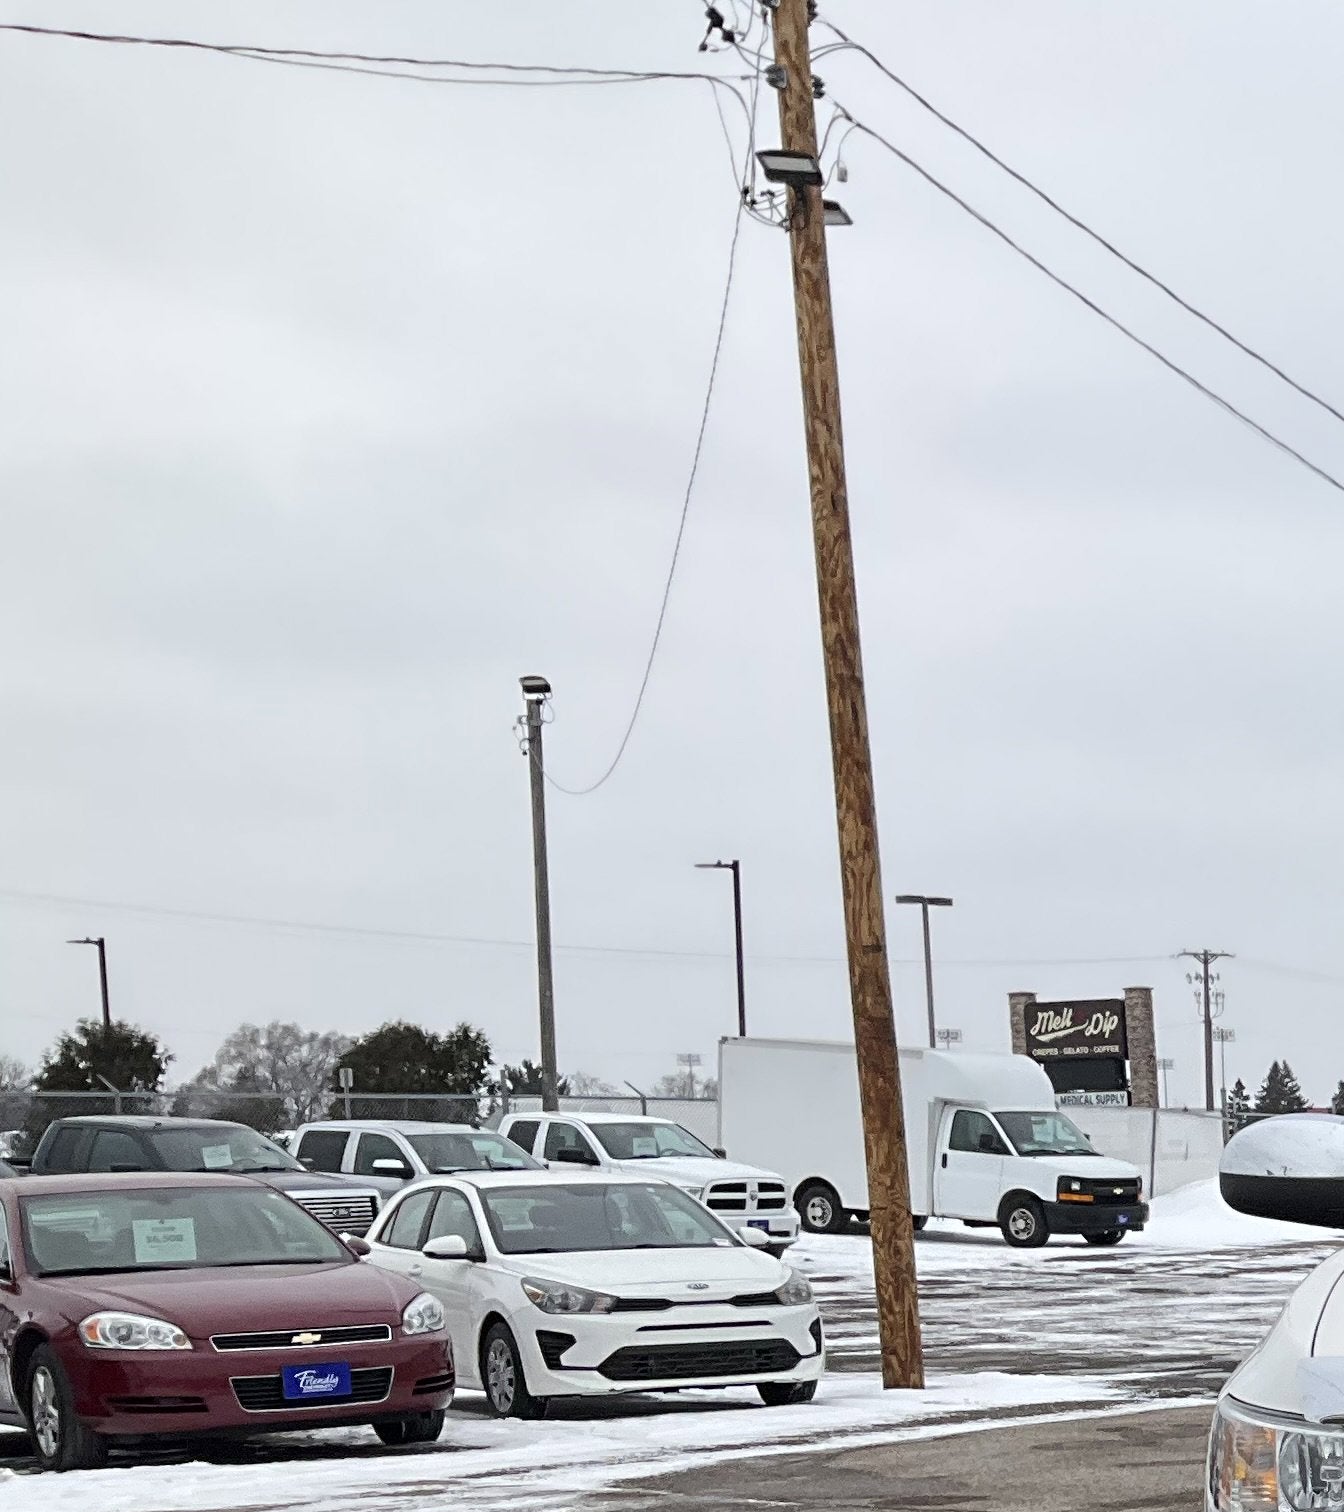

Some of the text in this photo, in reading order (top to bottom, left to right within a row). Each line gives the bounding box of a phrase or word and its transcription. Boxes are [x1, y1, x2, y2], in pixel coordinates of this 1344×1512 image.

[1030, 1007, 1119, 1039] Melt Dip
[1060, 1094, 1125, 1106] MEDICAL SUPPLY
[293, 1369, 339, 1388] Friendly
